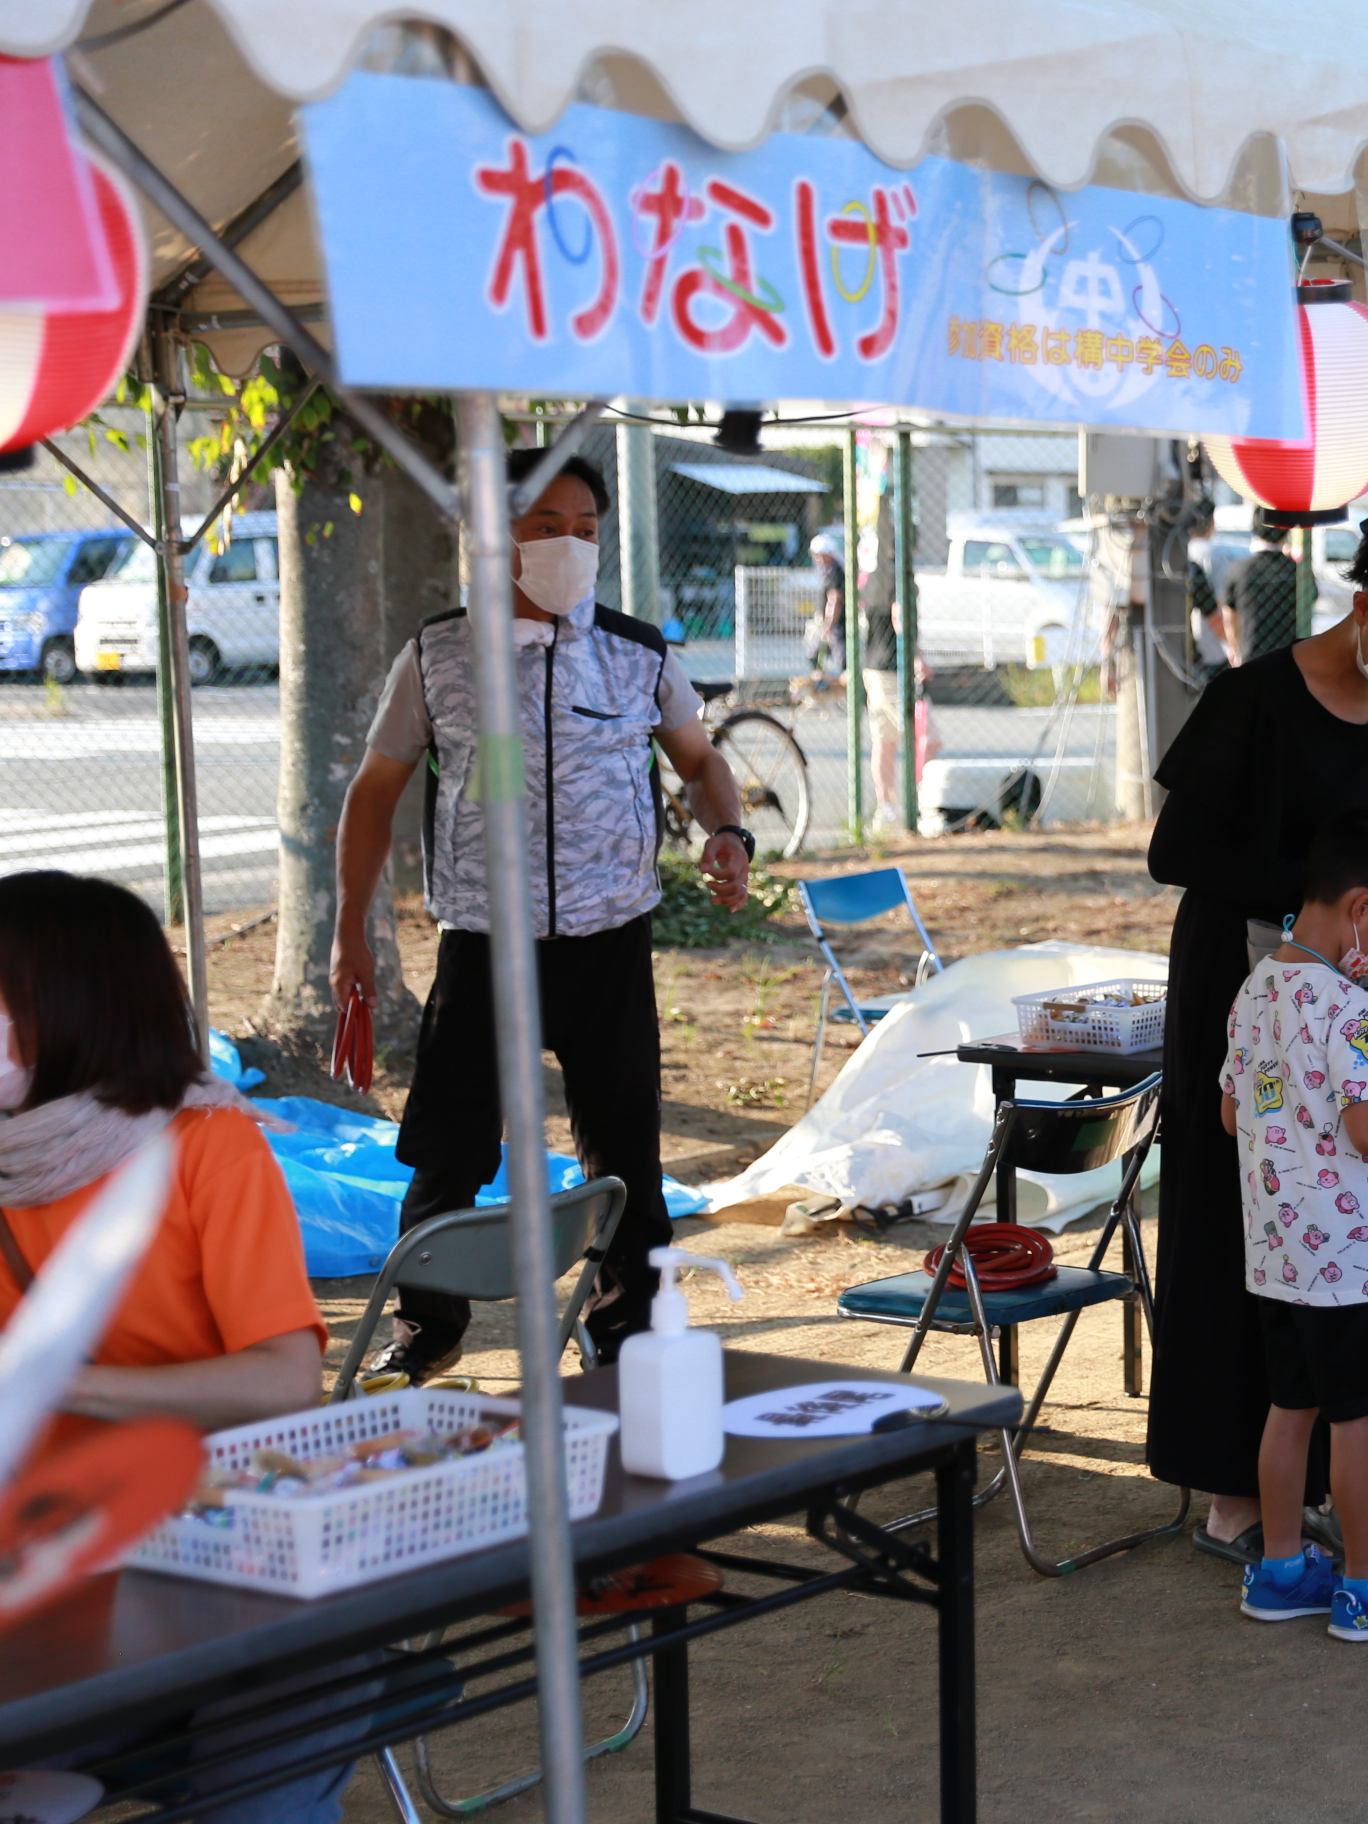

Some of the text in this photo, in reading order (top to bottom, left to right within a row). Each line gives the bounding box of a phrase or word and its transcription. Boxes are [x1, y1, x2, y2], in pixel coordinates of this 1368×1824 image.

[476, 137, 918, 360] わなげ
[946, 312, 1245, 385] 参加資格は構中学会のみ
